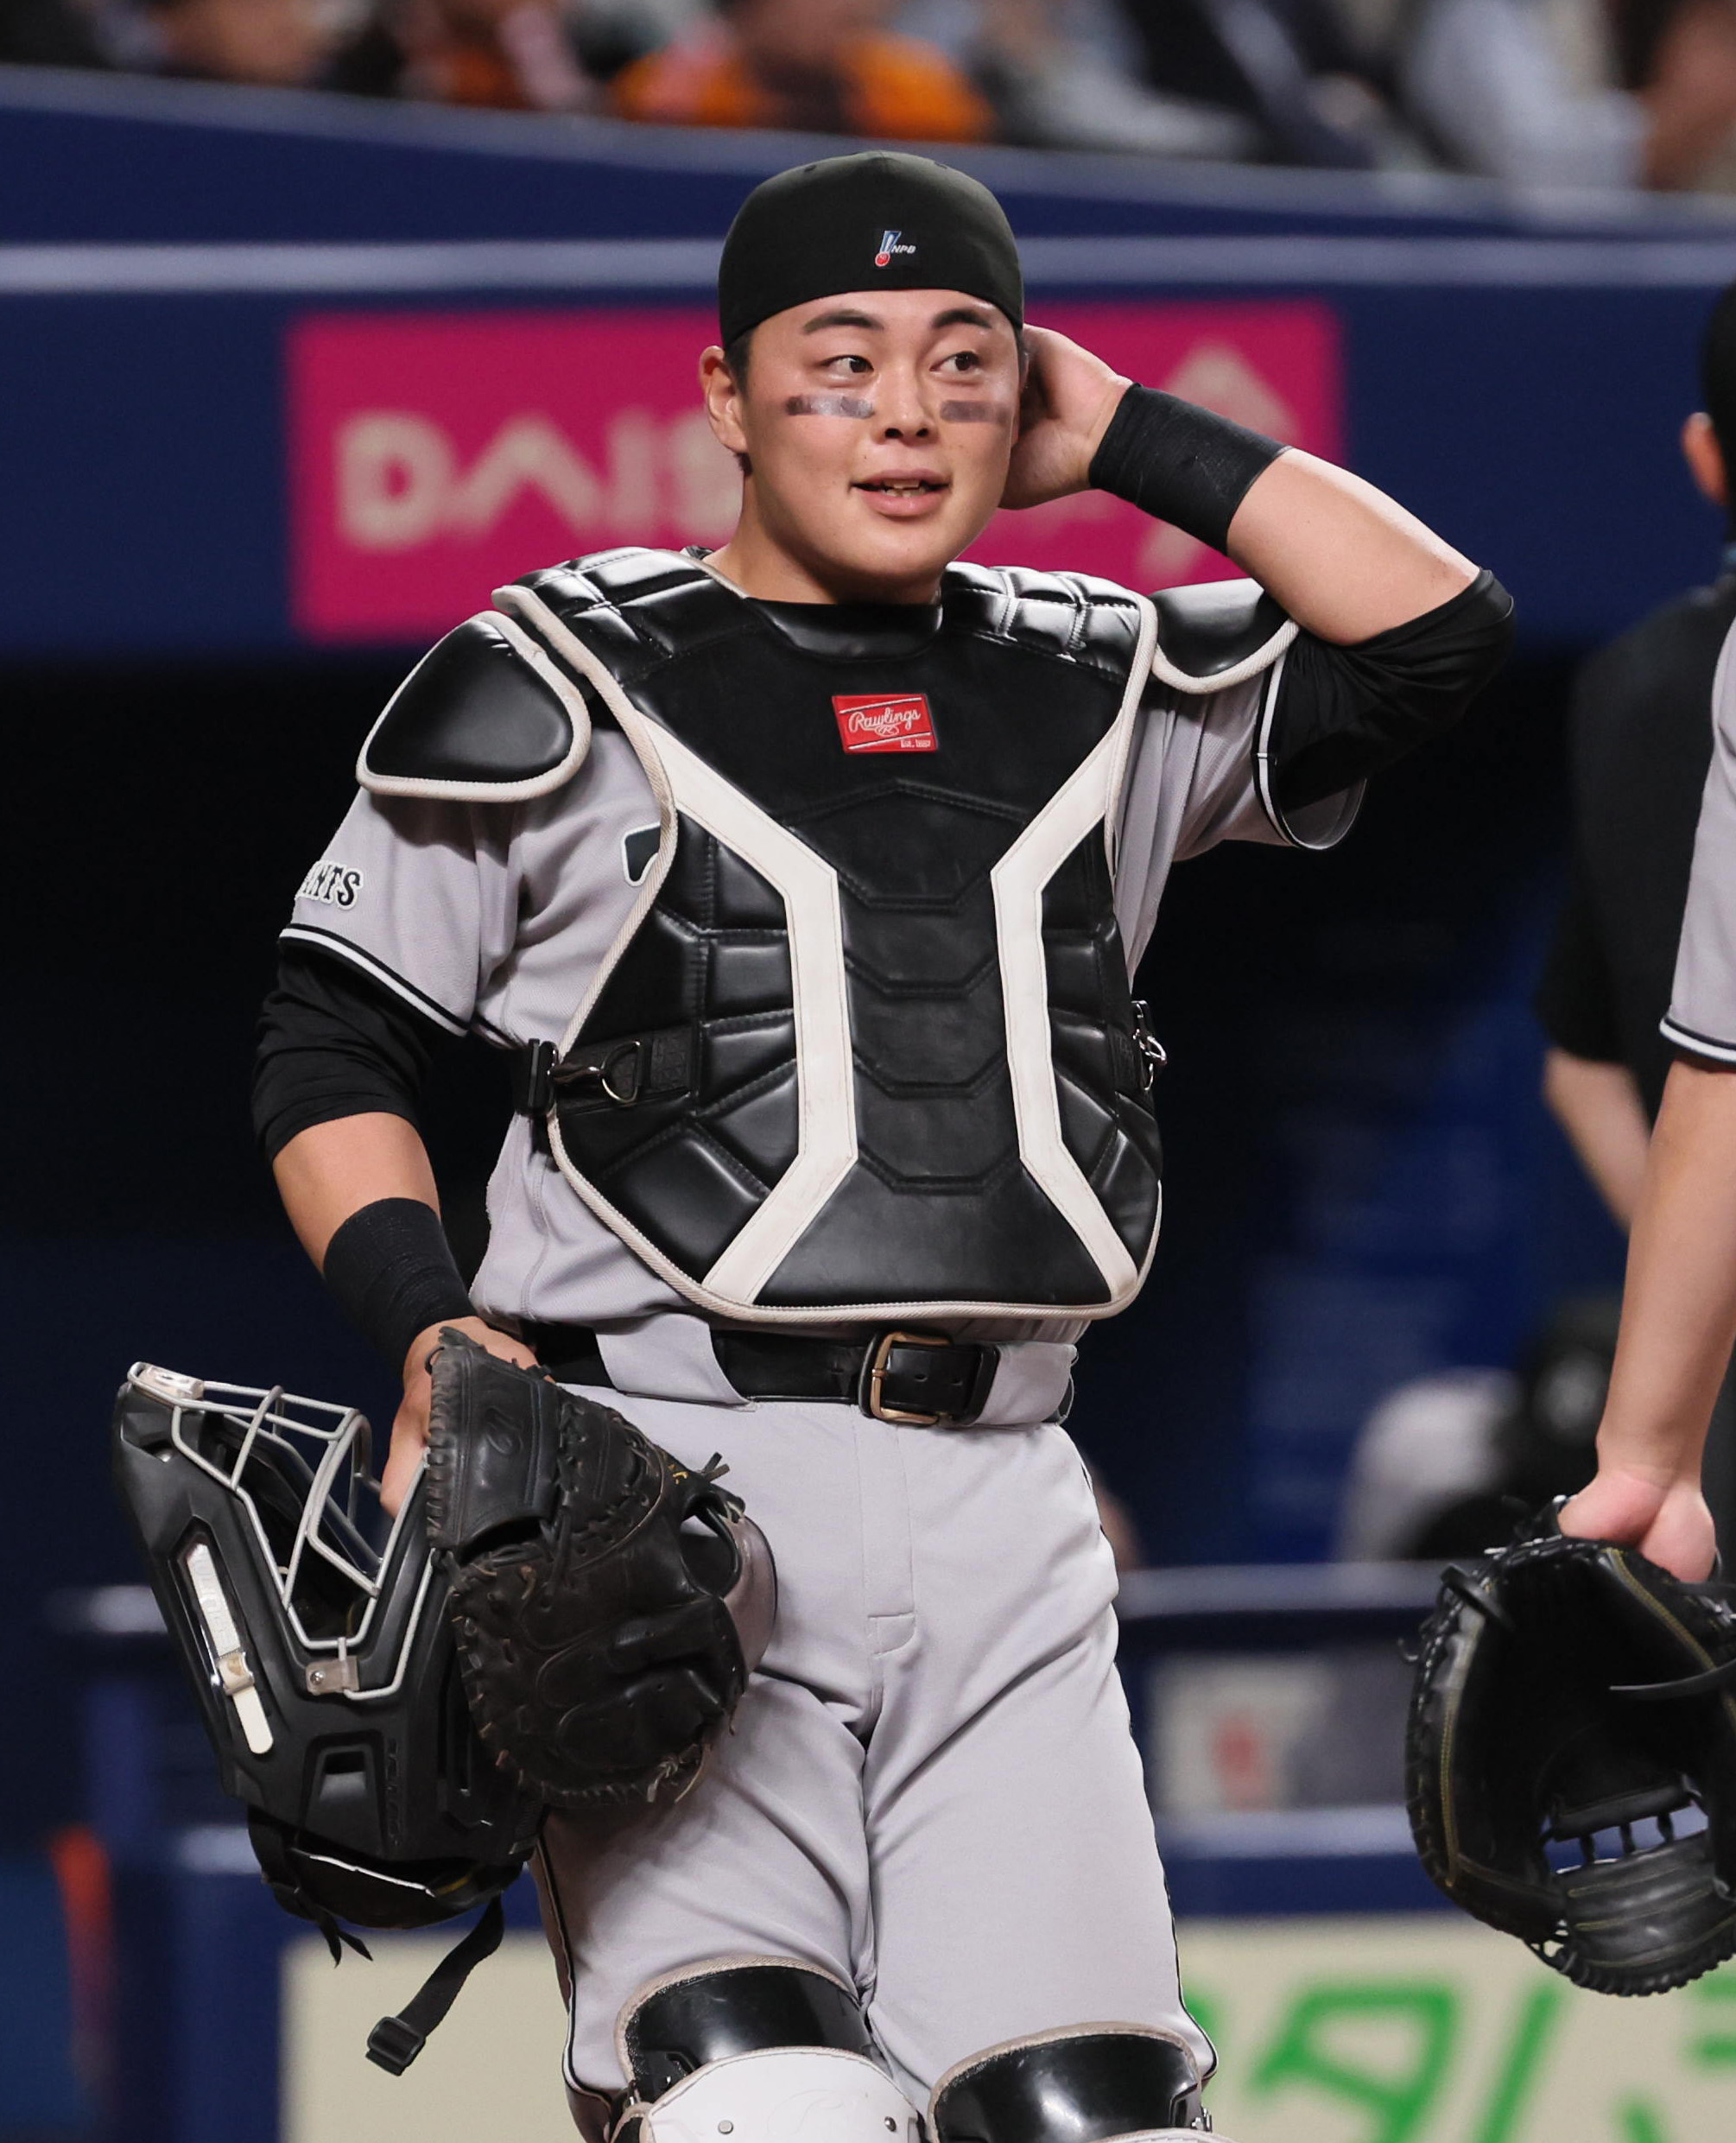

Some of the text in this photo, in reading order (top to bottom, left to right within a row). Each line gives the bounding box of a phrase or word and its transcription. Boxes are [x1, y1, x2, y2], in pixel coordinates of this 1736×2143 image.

[890, 244, 916, 254] NPB
[848, 707, 921, 732] Rawlings
[296, 863, 362, 908] NTS
